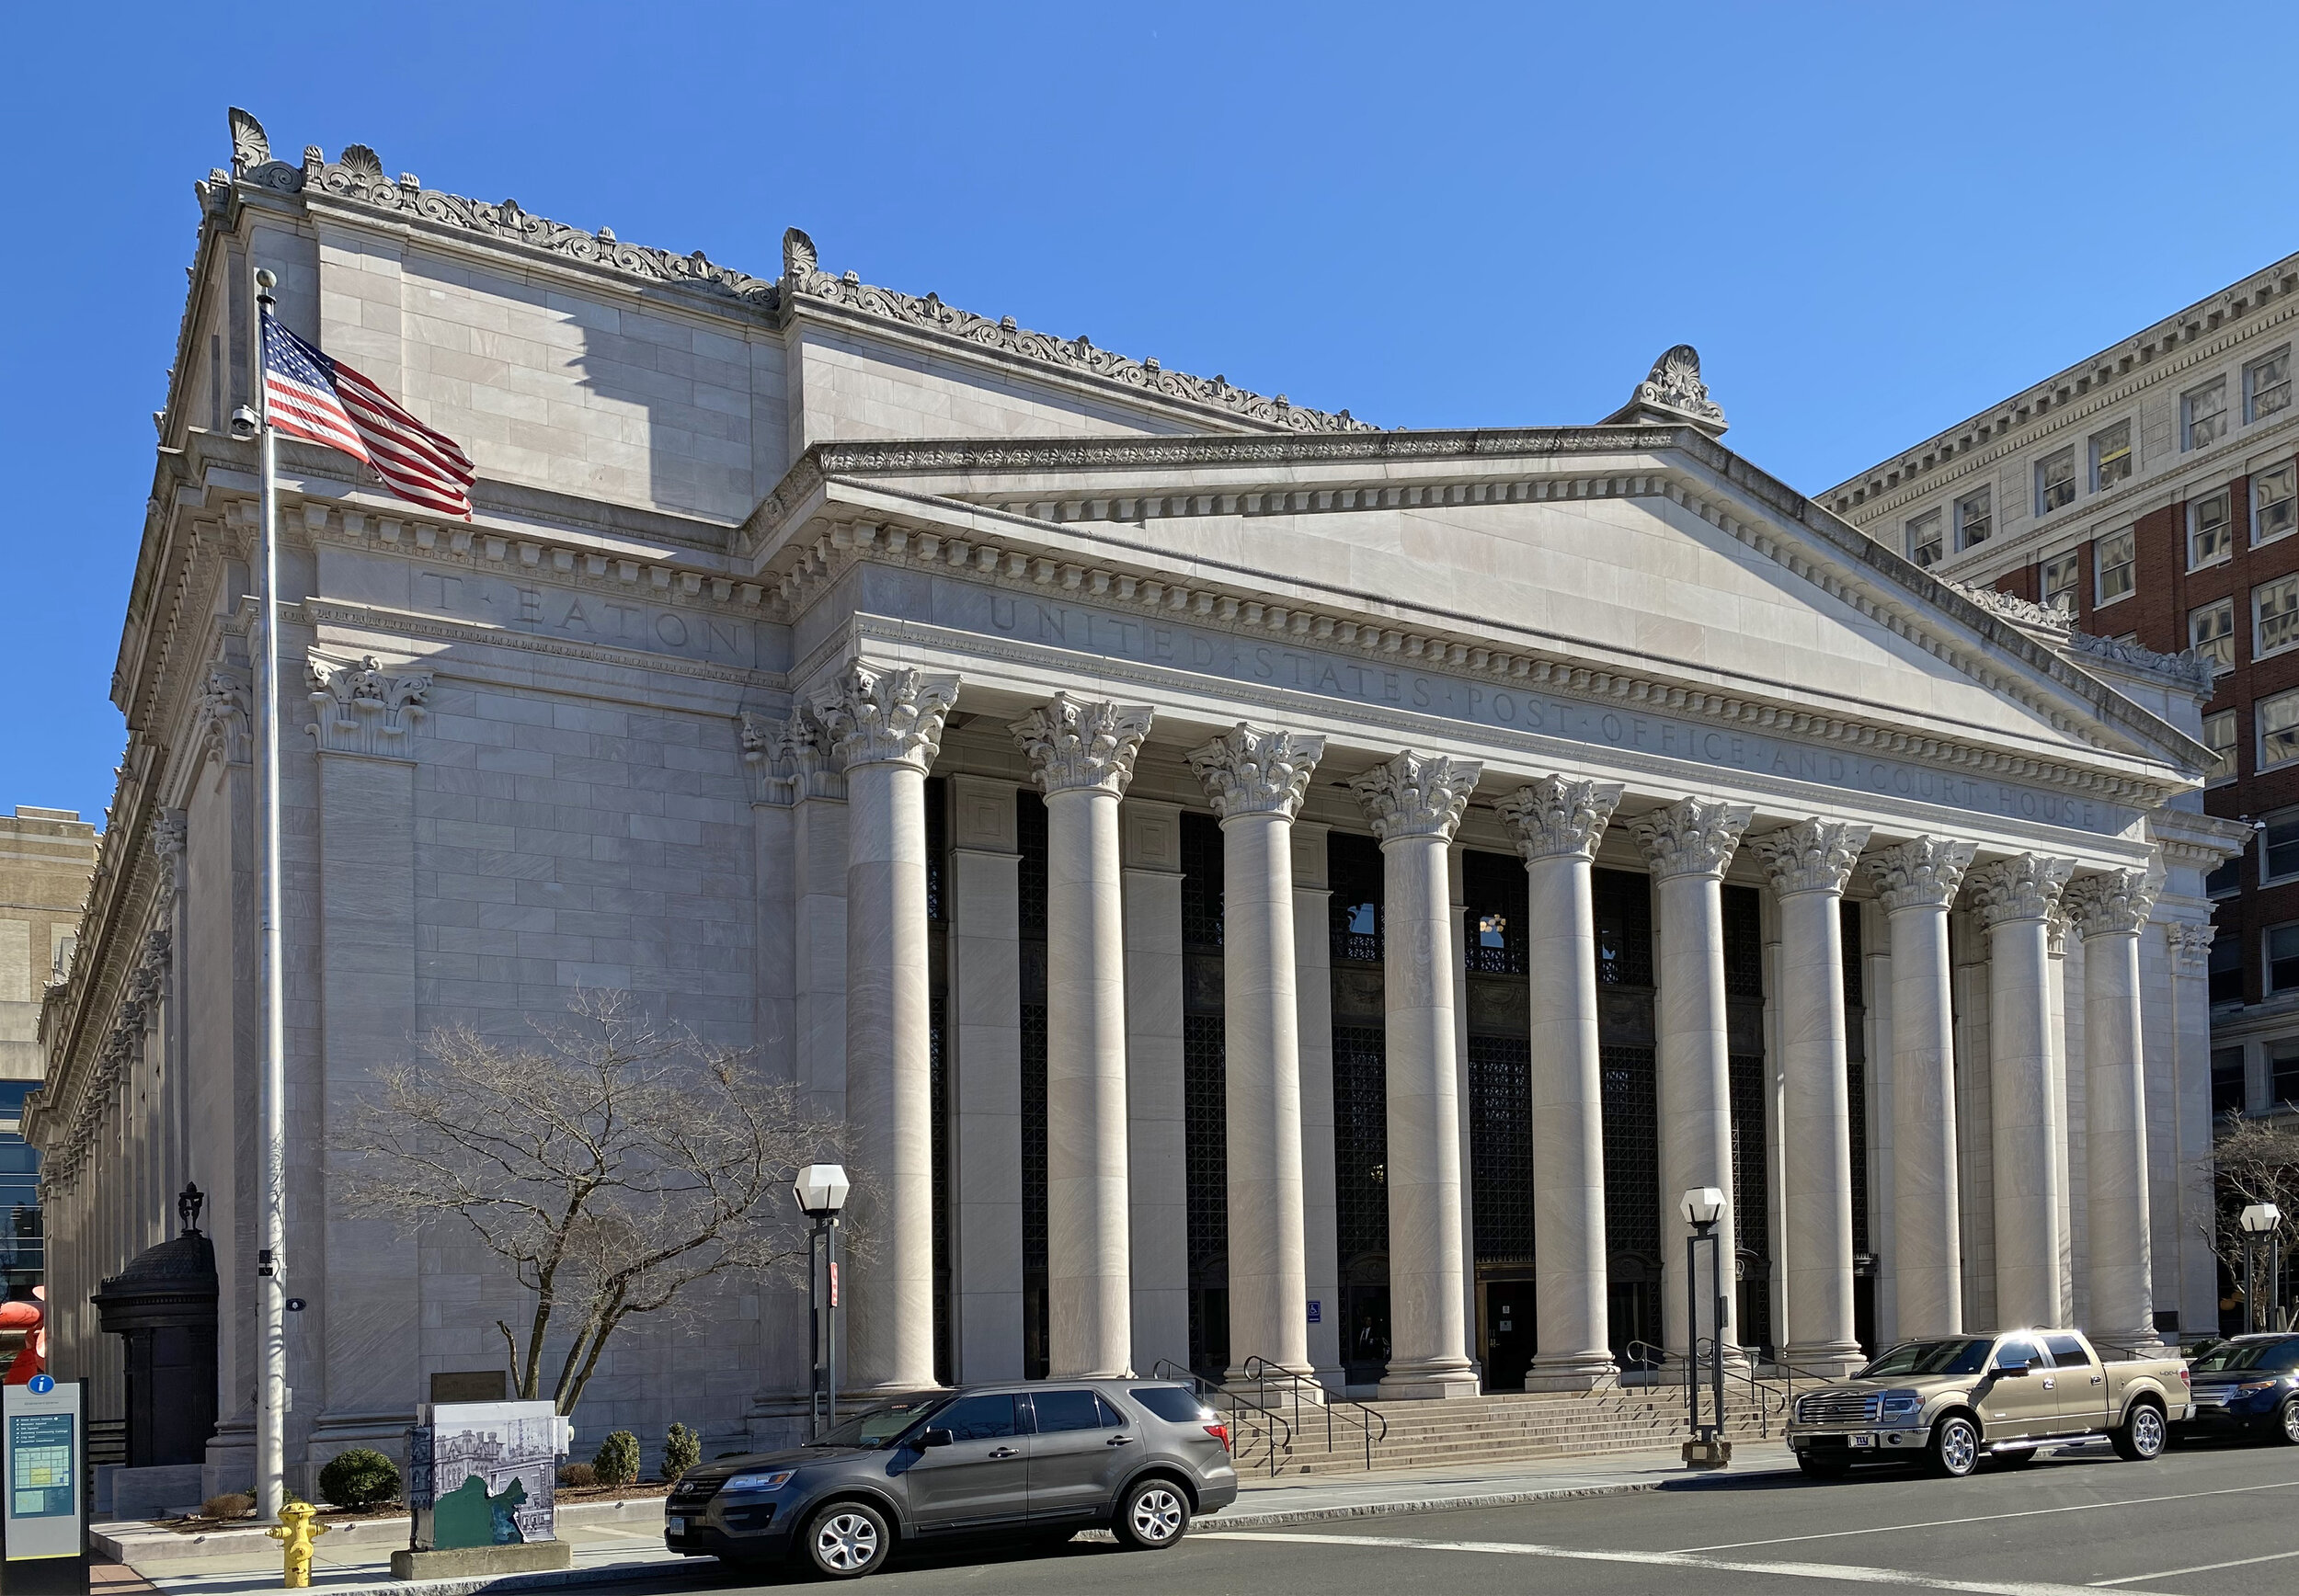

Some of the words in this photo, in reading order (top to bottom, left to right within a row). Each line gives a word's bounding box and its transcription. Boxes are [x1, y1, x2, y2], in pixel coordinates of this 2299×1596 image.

[420, 571, 463, 610] T
[511, 586, 745, 657] EATON
[985, 593, 1222, 667] UNITED
[1253, 647, 1431, 708] STATES
[1465, 686, 1574, 734] POST
[1601, 713, 1746, 764] OFFICE
[1771, 747, 1845, 781] AND
[1870, 764, 1977, 805] COURT
[1998, 787, 2094, 827] HOUSE
